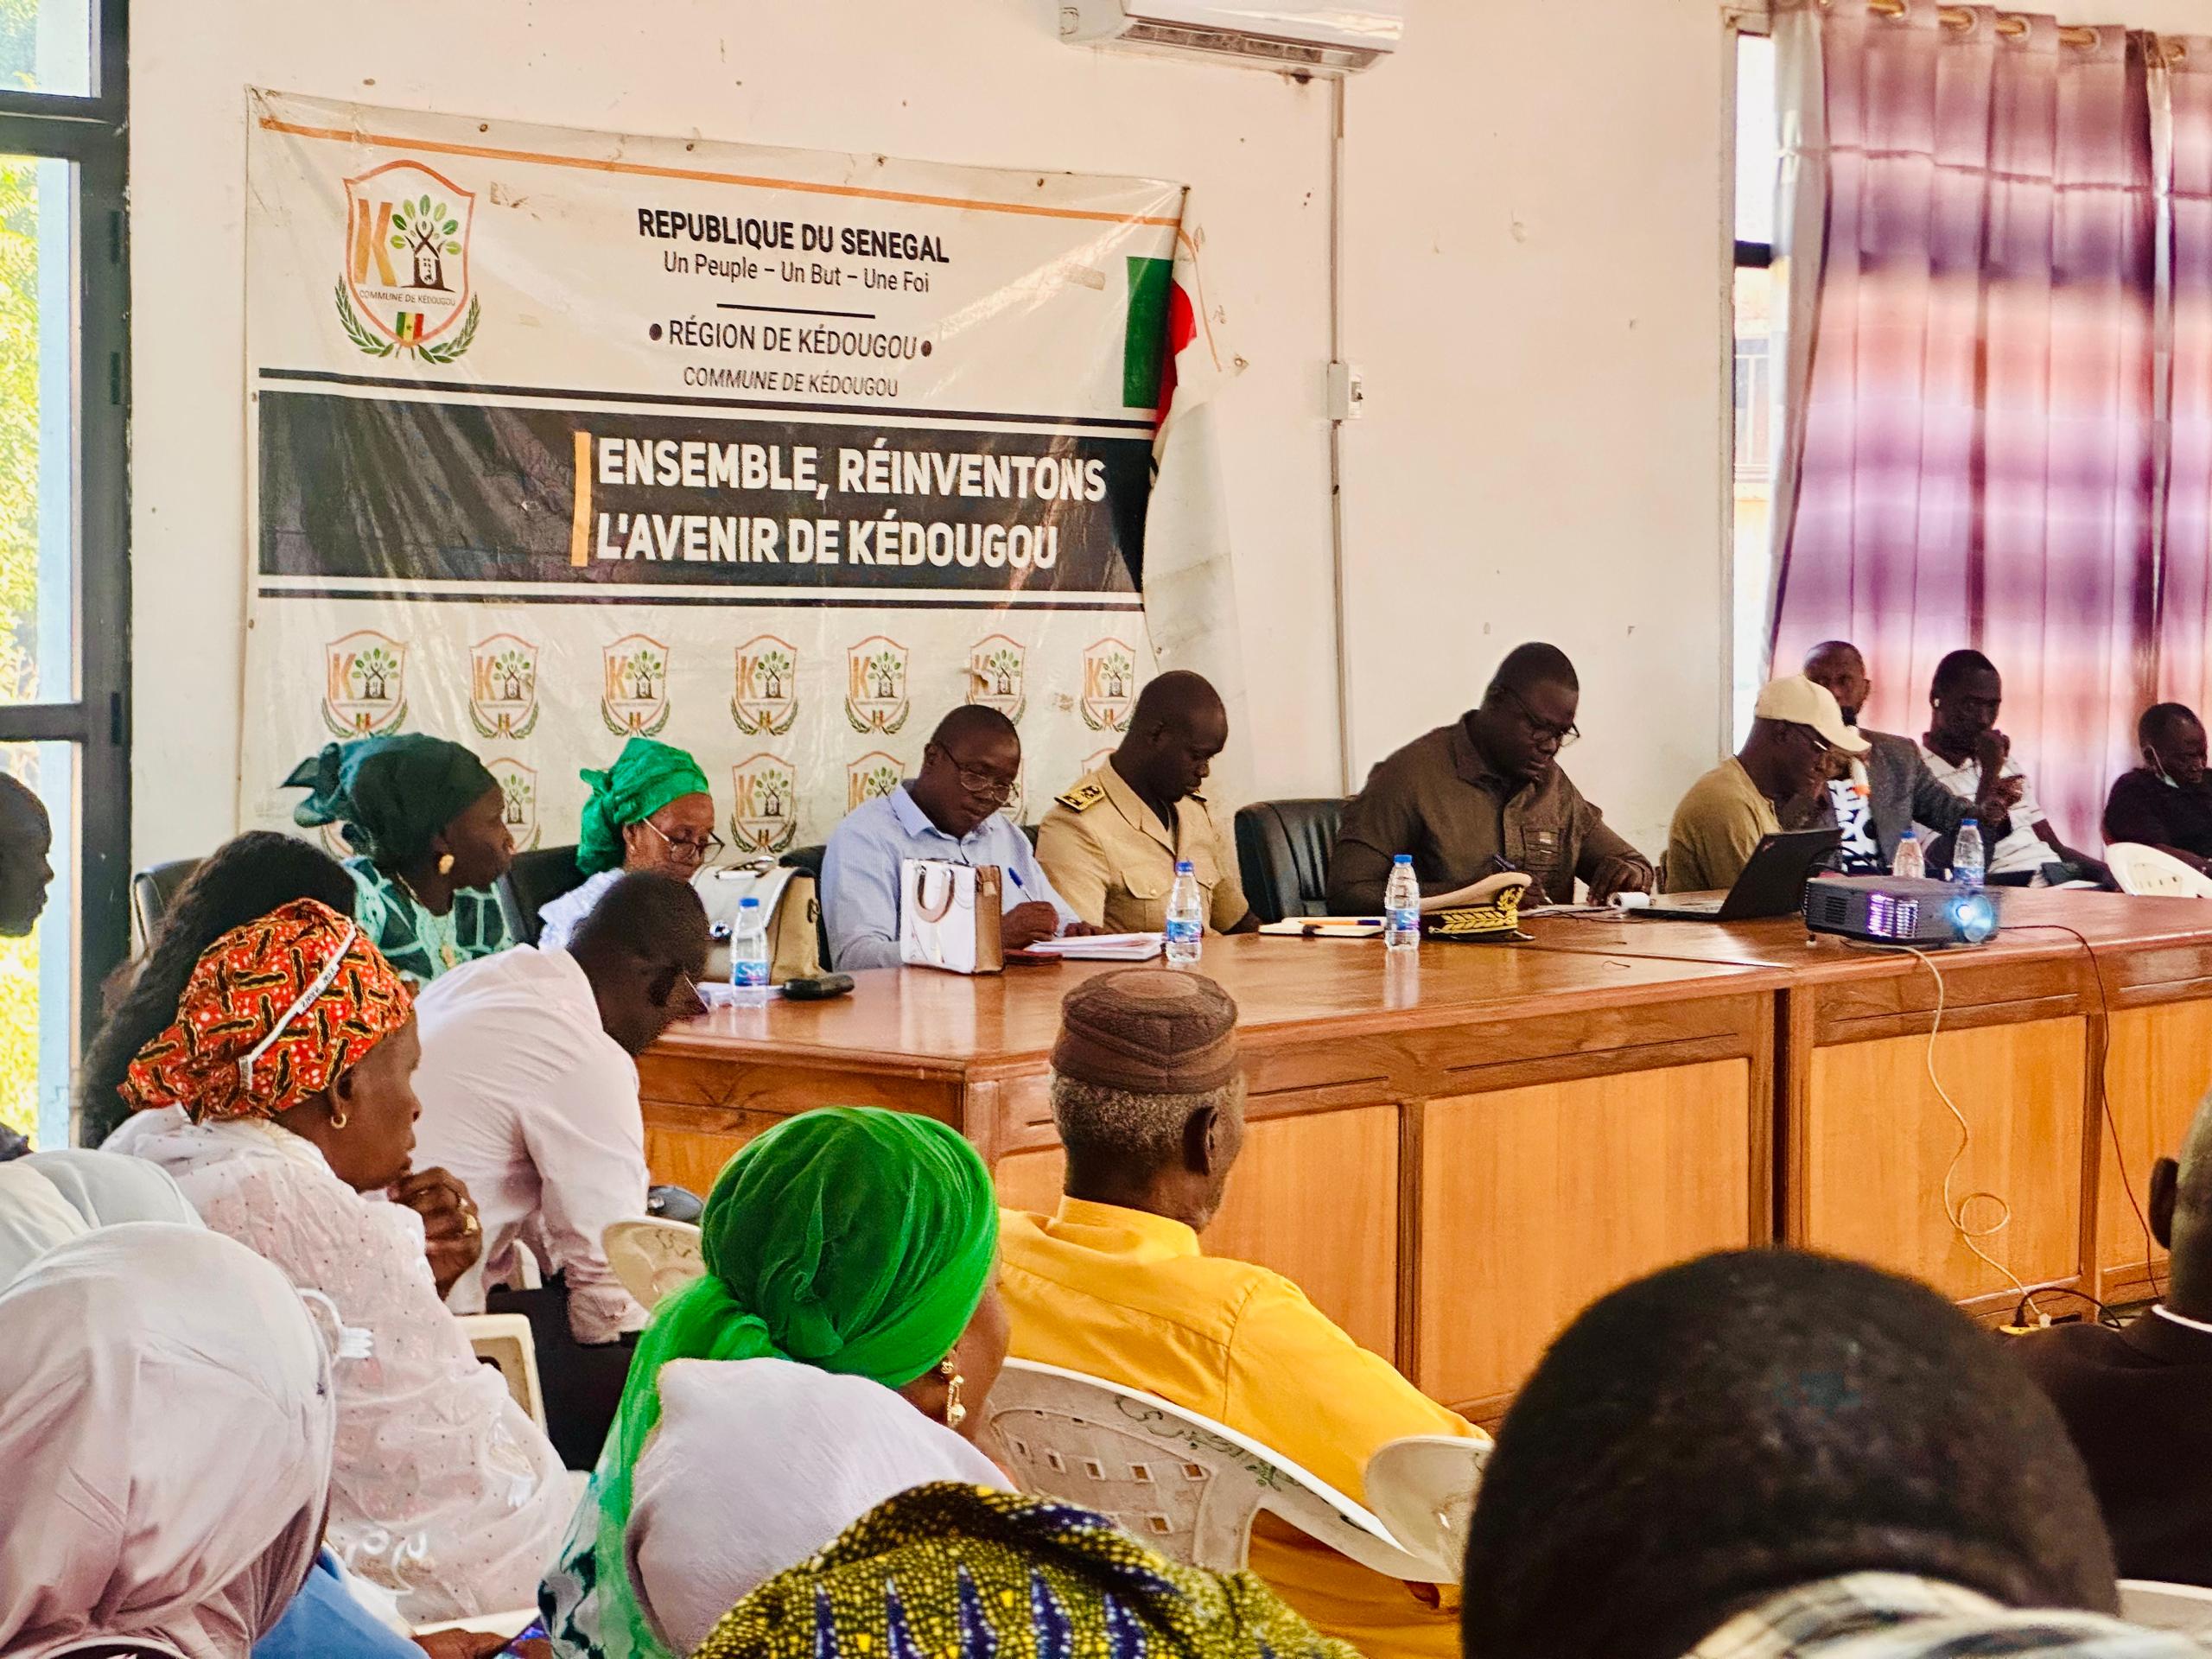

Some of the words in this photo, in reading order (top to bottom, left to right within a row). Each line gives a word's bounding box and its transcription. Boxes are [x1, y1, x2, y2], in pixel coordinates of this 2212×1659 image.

[354, 199, 397, 287] K
[638, 208, 794, 250] REPUBLIQUE
[802, 224, 833, 252] DU
[842, 227, 950, 263] SENEGAL
[664, 251, 689, 273] Un
[695, 254, 758, 283] Peuple
[781, 261, 804, 283] Un
[811, 264, 841, 286] But
[864, 268, 897, 290] Une
[904, 271, 929, 293] Foi
[670, 315, 755, 350] RÉGION
[764, 327, 791, 353] DE
[798, 323, 917, 359] KÉDOUGOU
[683, 366, 779, 391] COMMUNE
[783, 372, 804, 391] DE
[809, 370, 898, 397] KÉDOUGOU
[599, 437, 829, 500] ENSEMBLE,
[838, 436, 1107, 502] RÉINVENTONS
[597, 512, 779, 563] L'AVENIR
[788, 518, 839, 564] DE
[849, 508, 1058, 569] KÉDOUGOU
